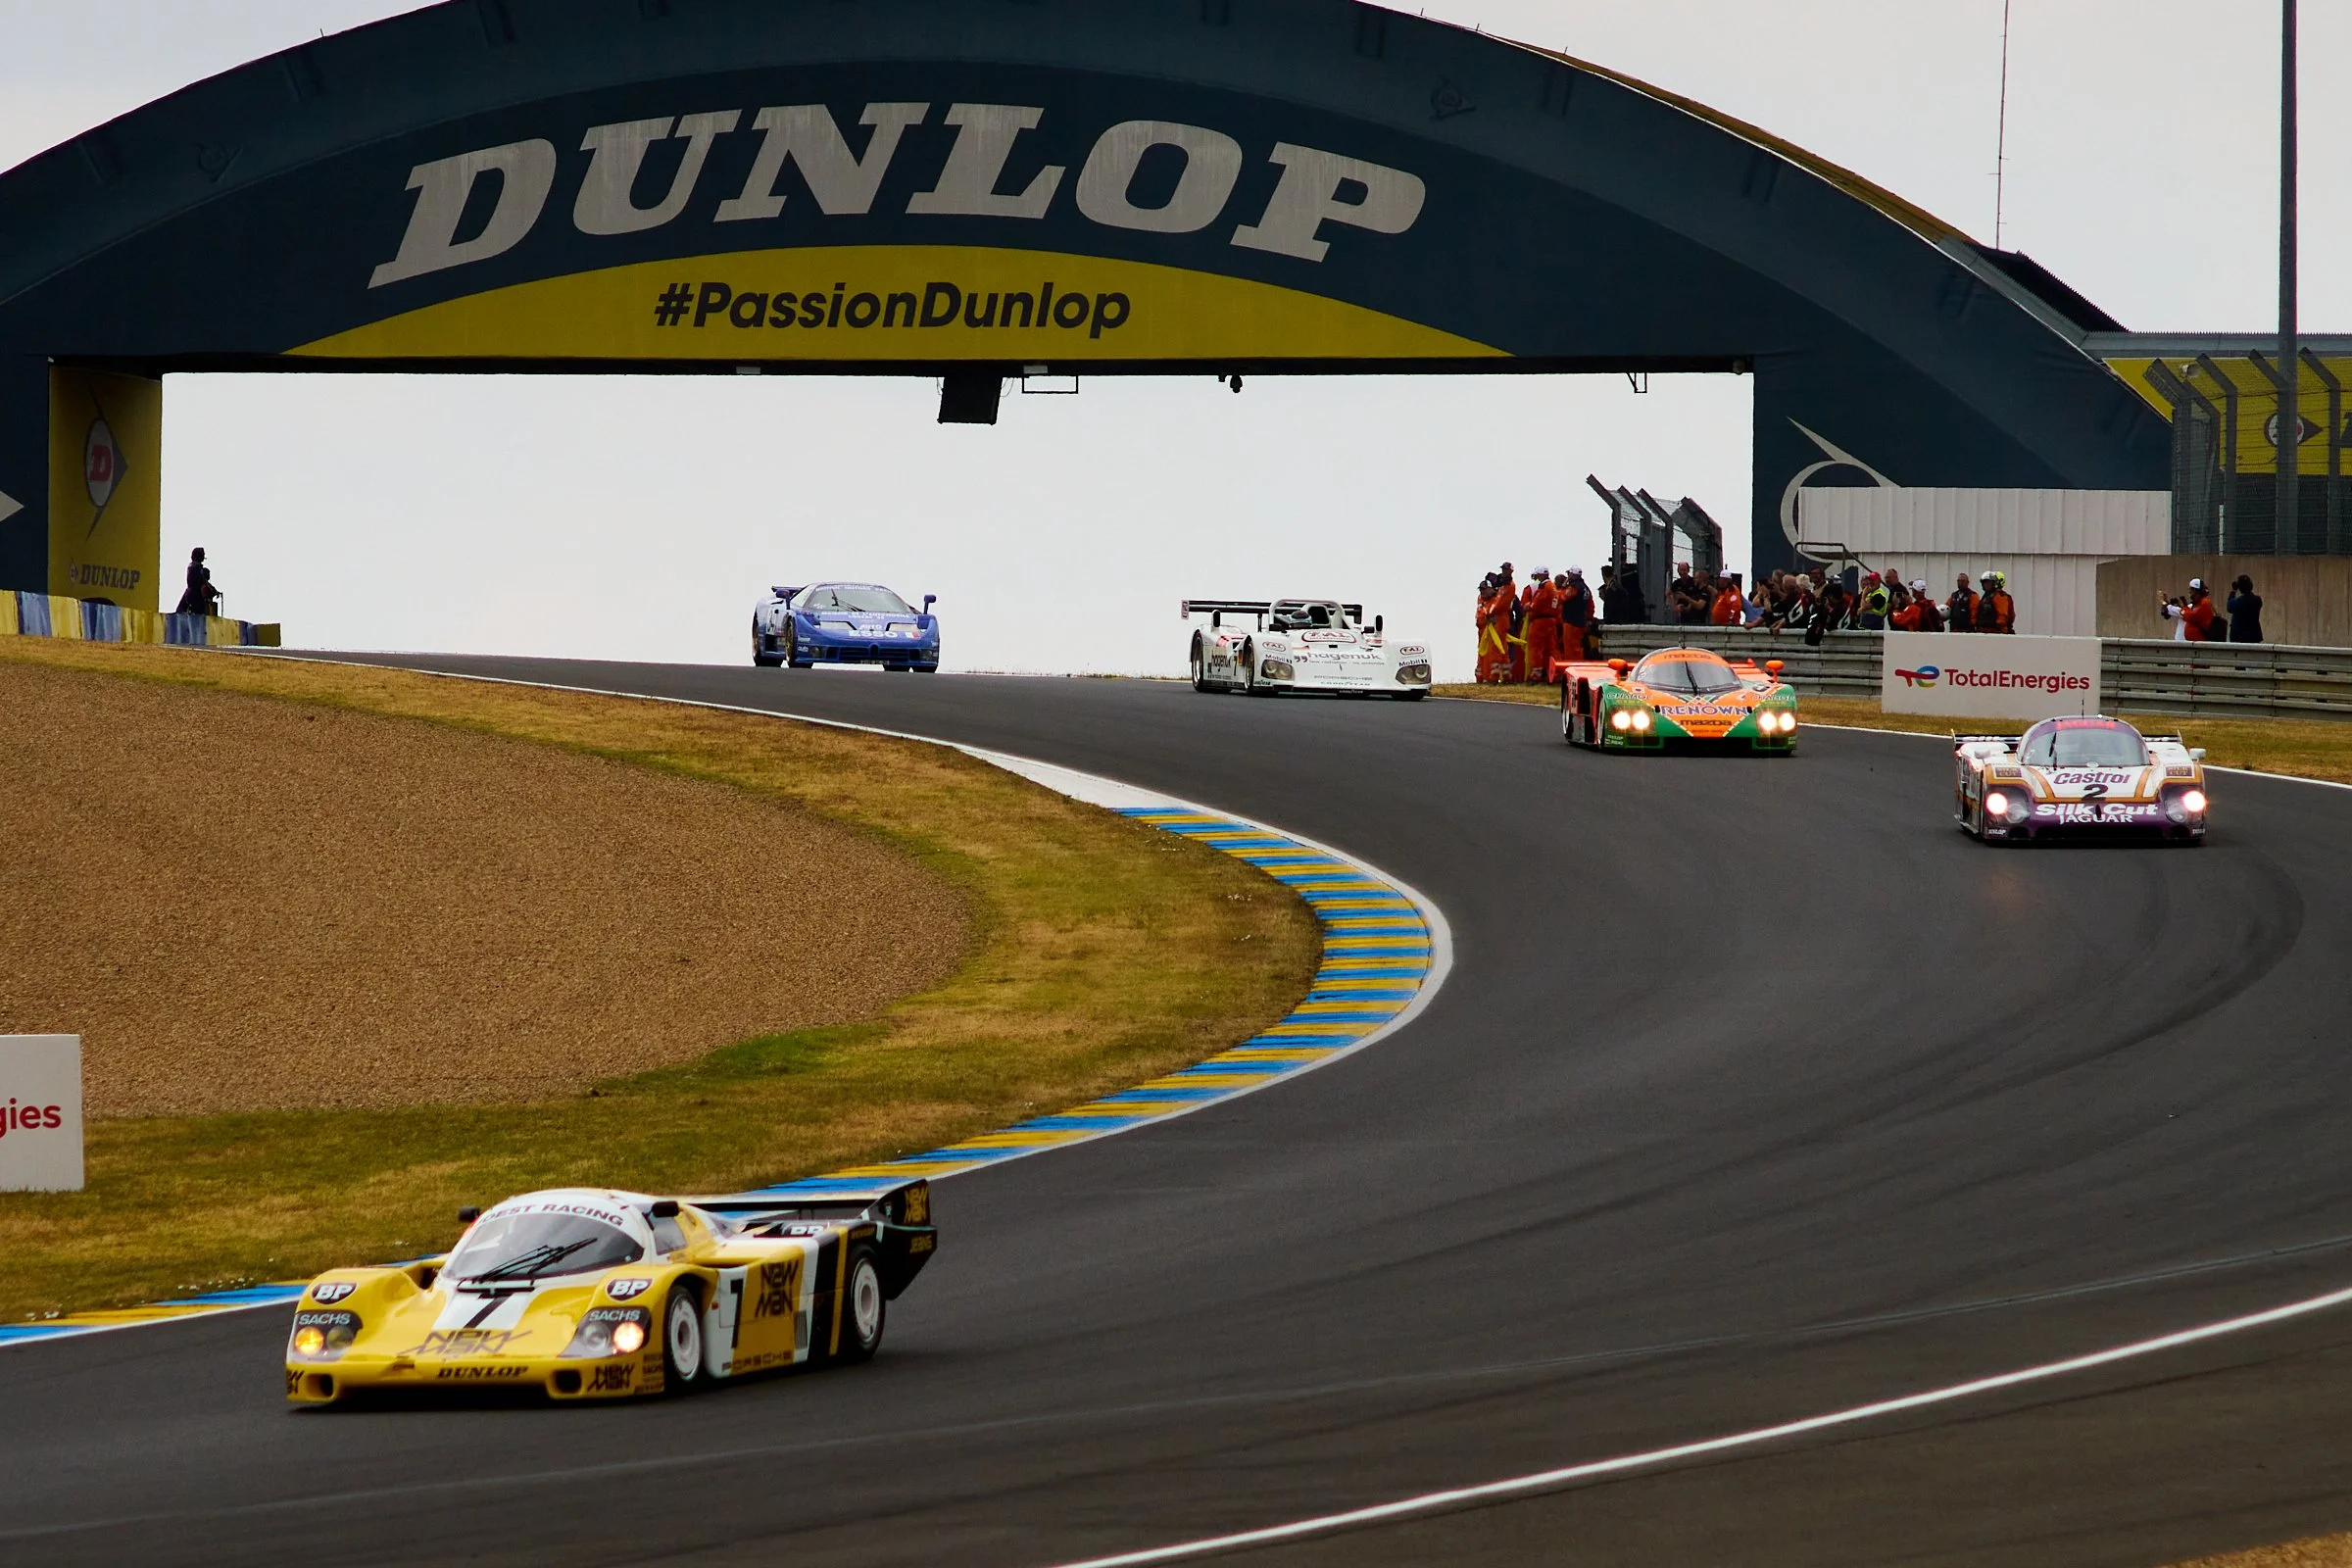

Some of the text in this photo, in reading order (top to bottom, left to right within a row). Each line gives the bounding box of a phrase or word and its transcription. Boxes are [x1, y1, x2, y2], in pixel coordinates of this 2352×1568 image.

[368, 102, 1426, 290] DUNLOP
[655, 282, 1131, 339] #PassionDunlop
[80, 564, 140, 590] DUNLOP
[1944, 668, 2090, 693] TotalEnergies
[1660, 706, 1748, 715] RENOWN
[2053, 771, 2130, 785] Castrol
[2081, 784, 2109, 802] 2
[2034, 803, 2158, 815] Silk Cut
[2059, 813, 2133, 825] JAGUAR
[542, 1203, 624, 1227] RACING
[789, 1224, 824, 1236] BP
[317, 1284, 354, 1300] BP
[611, 1279, 649, 1296] BP
[298, 1312, 351, 1325] SACHS
[588, 1309, 641, 1322] SACHS
[722, 1349, 793, 1373] PORSCHE
[437, 1366, 529, 1379] DUNLOP
